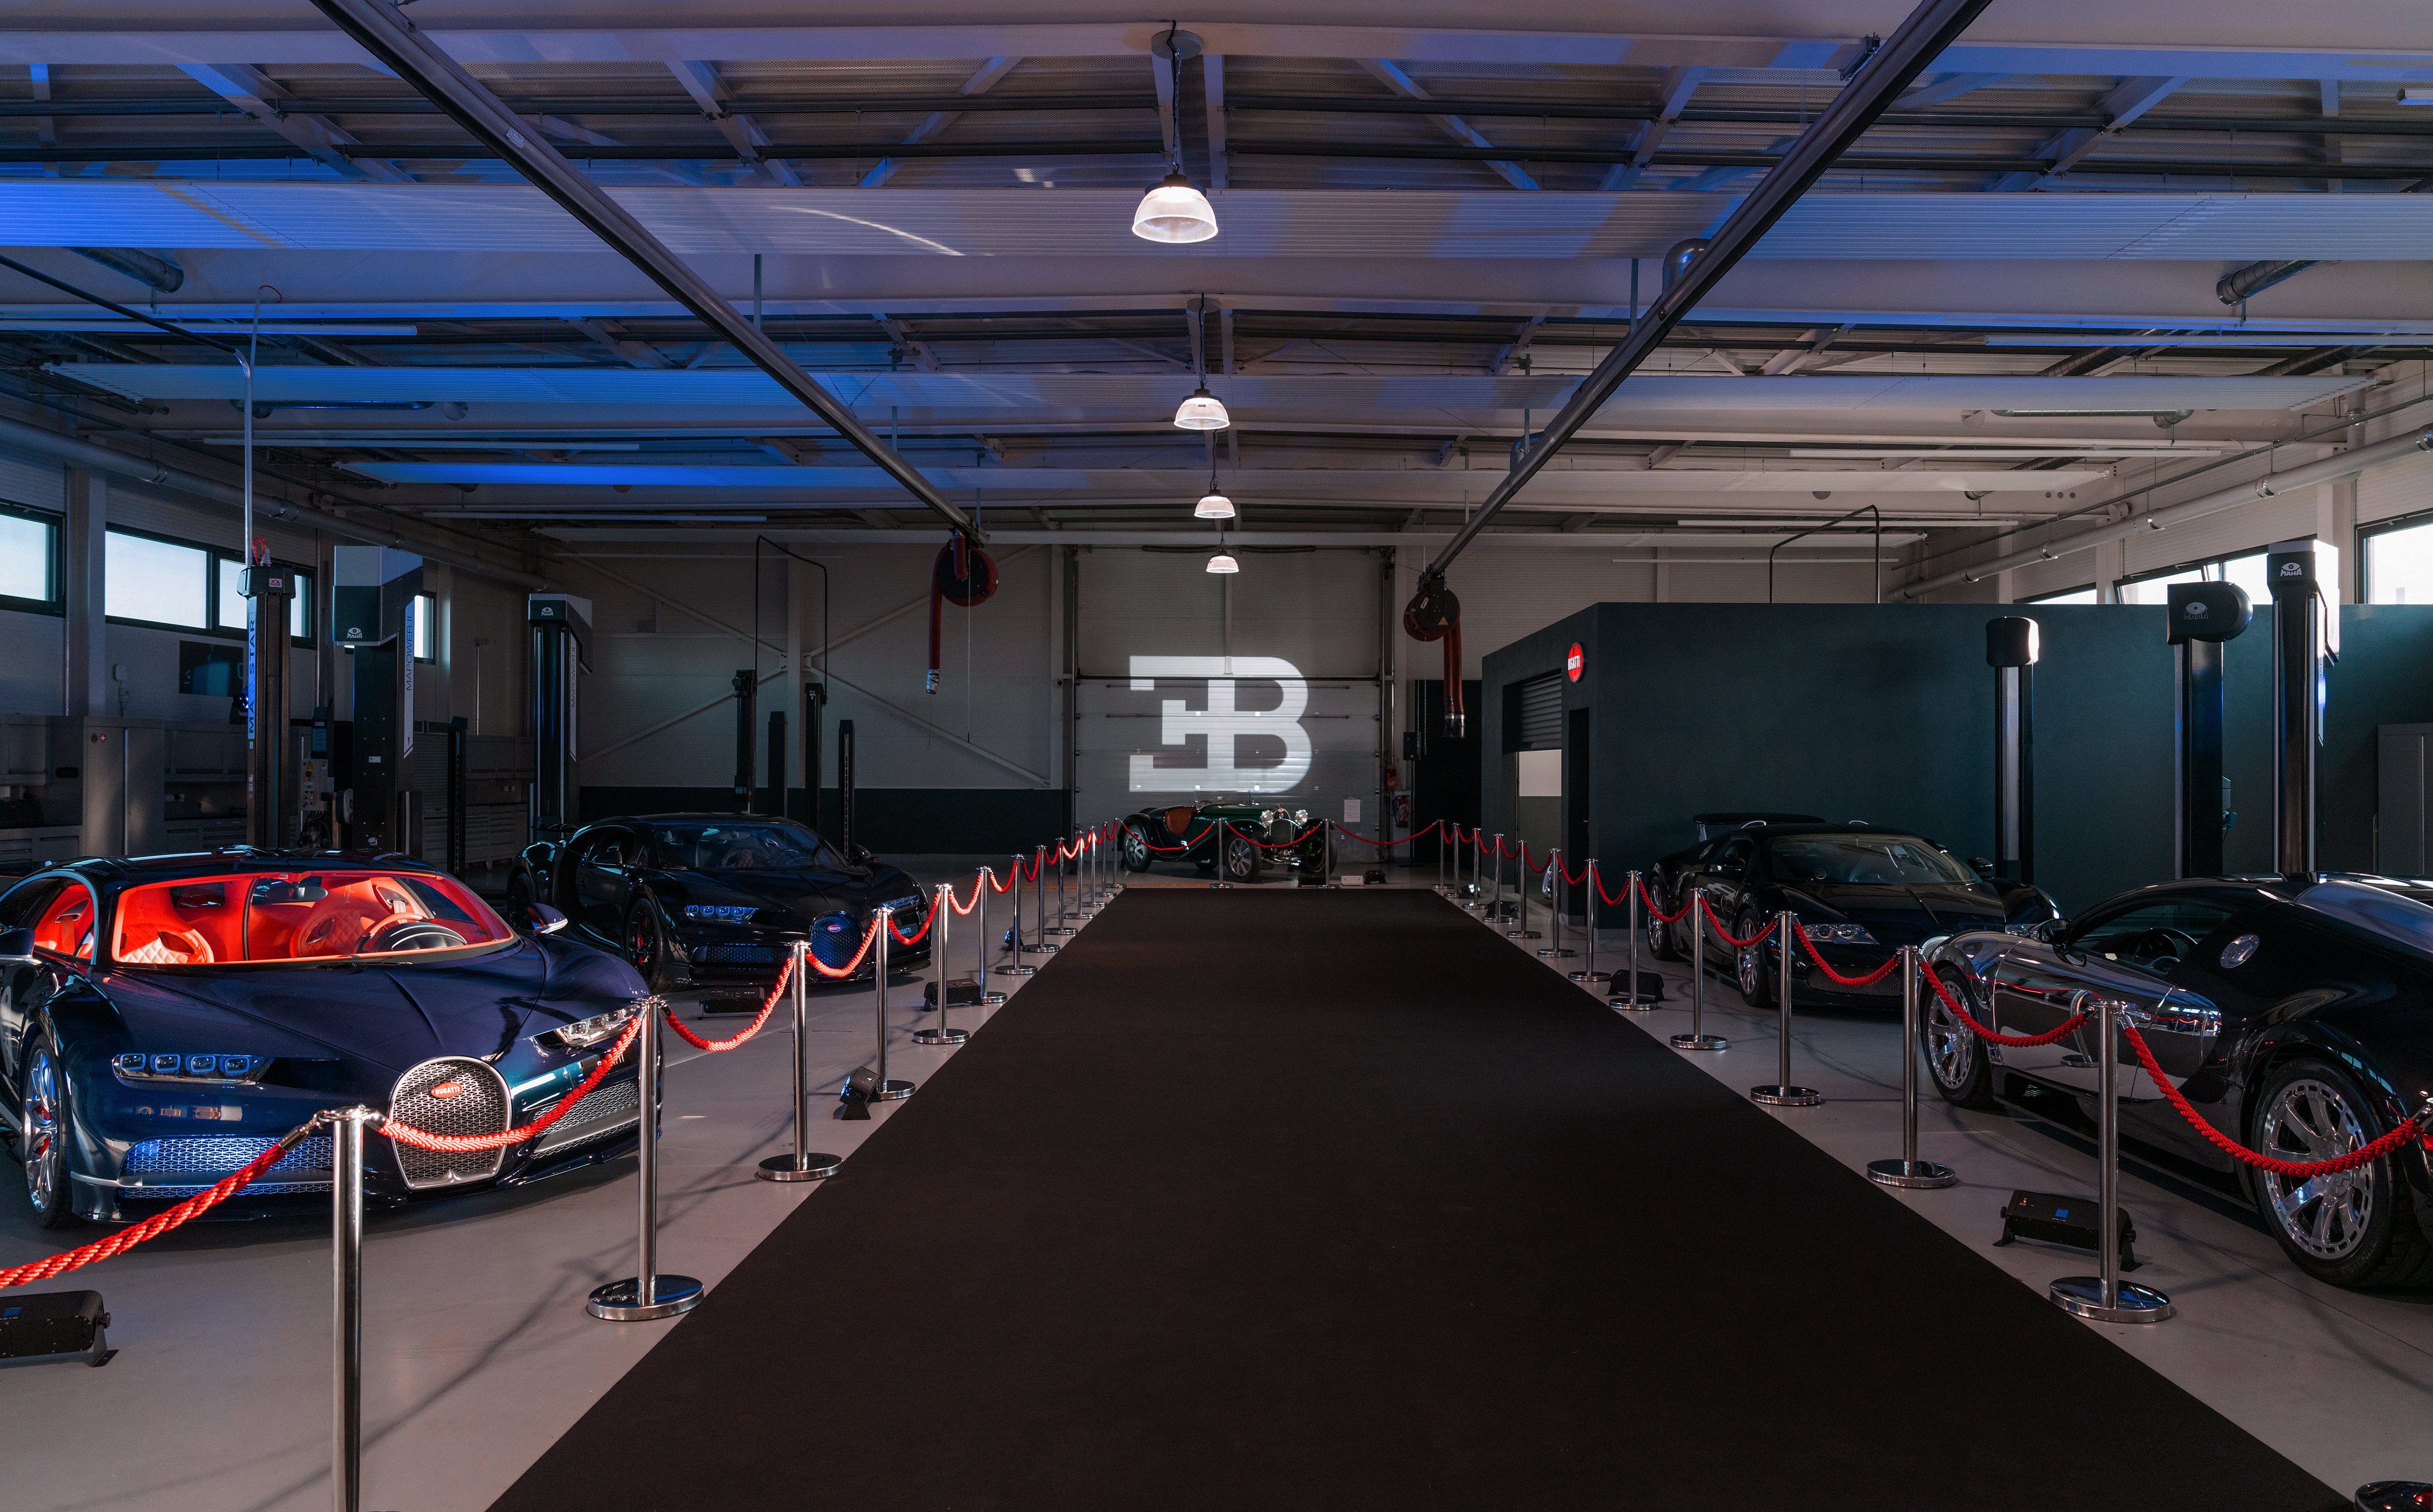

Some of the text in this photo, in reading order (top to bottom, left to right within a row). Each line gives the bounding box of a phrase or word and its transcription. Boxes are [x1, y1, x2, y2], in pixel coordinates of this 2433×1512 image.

[2280, 567, 2302, 576] MAHA
[2184, 609, 2208, 619] MAHA
[435, 1086, 460, 1095] BUGATTI
